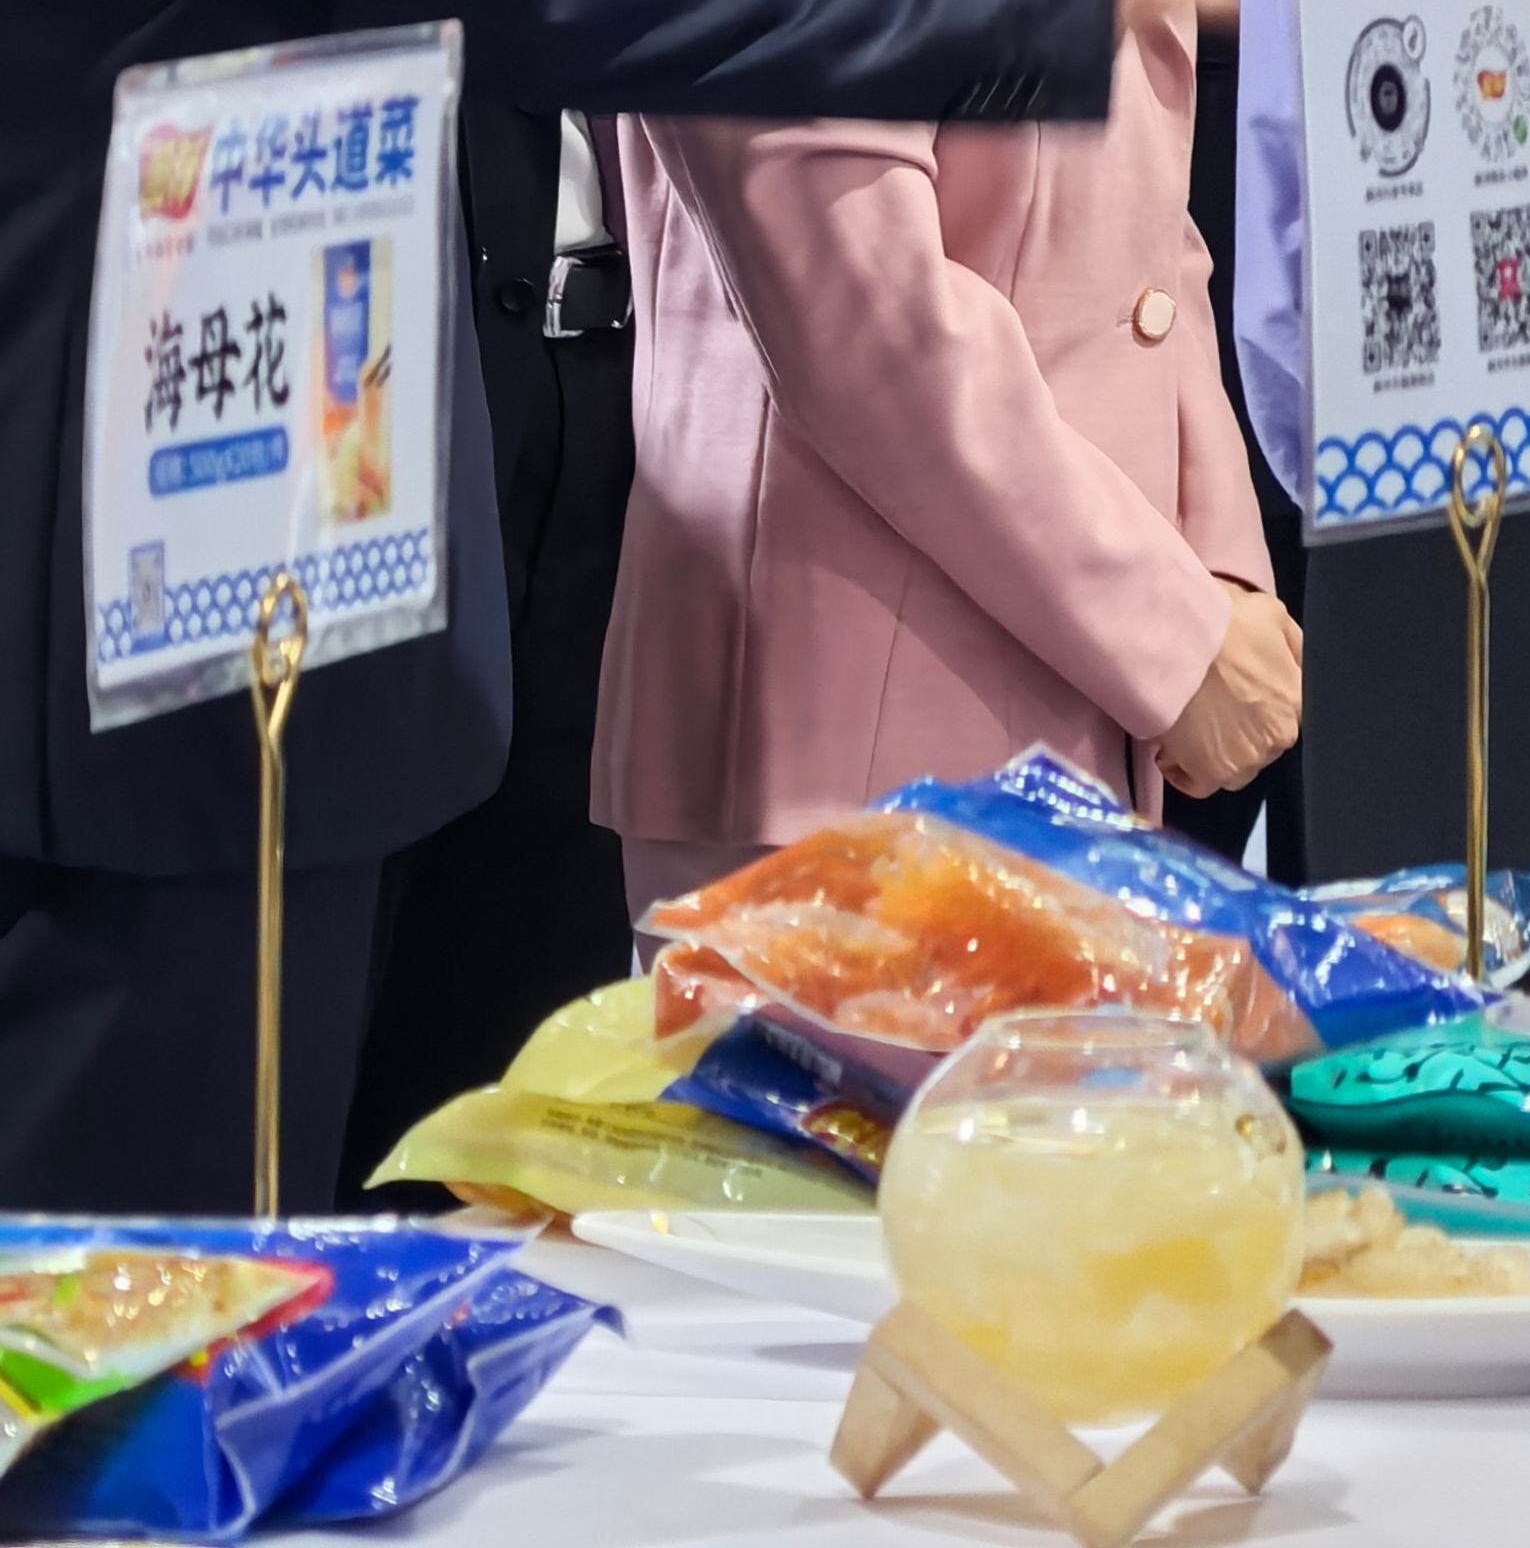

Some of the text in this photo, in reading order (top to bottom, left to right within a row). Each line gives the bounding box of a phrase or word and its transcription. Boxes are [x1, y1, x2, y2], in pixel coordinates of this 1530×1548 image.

[209, 94, 420, 215] 中华头道菜
[144, 292, 290, 435] 海母花
